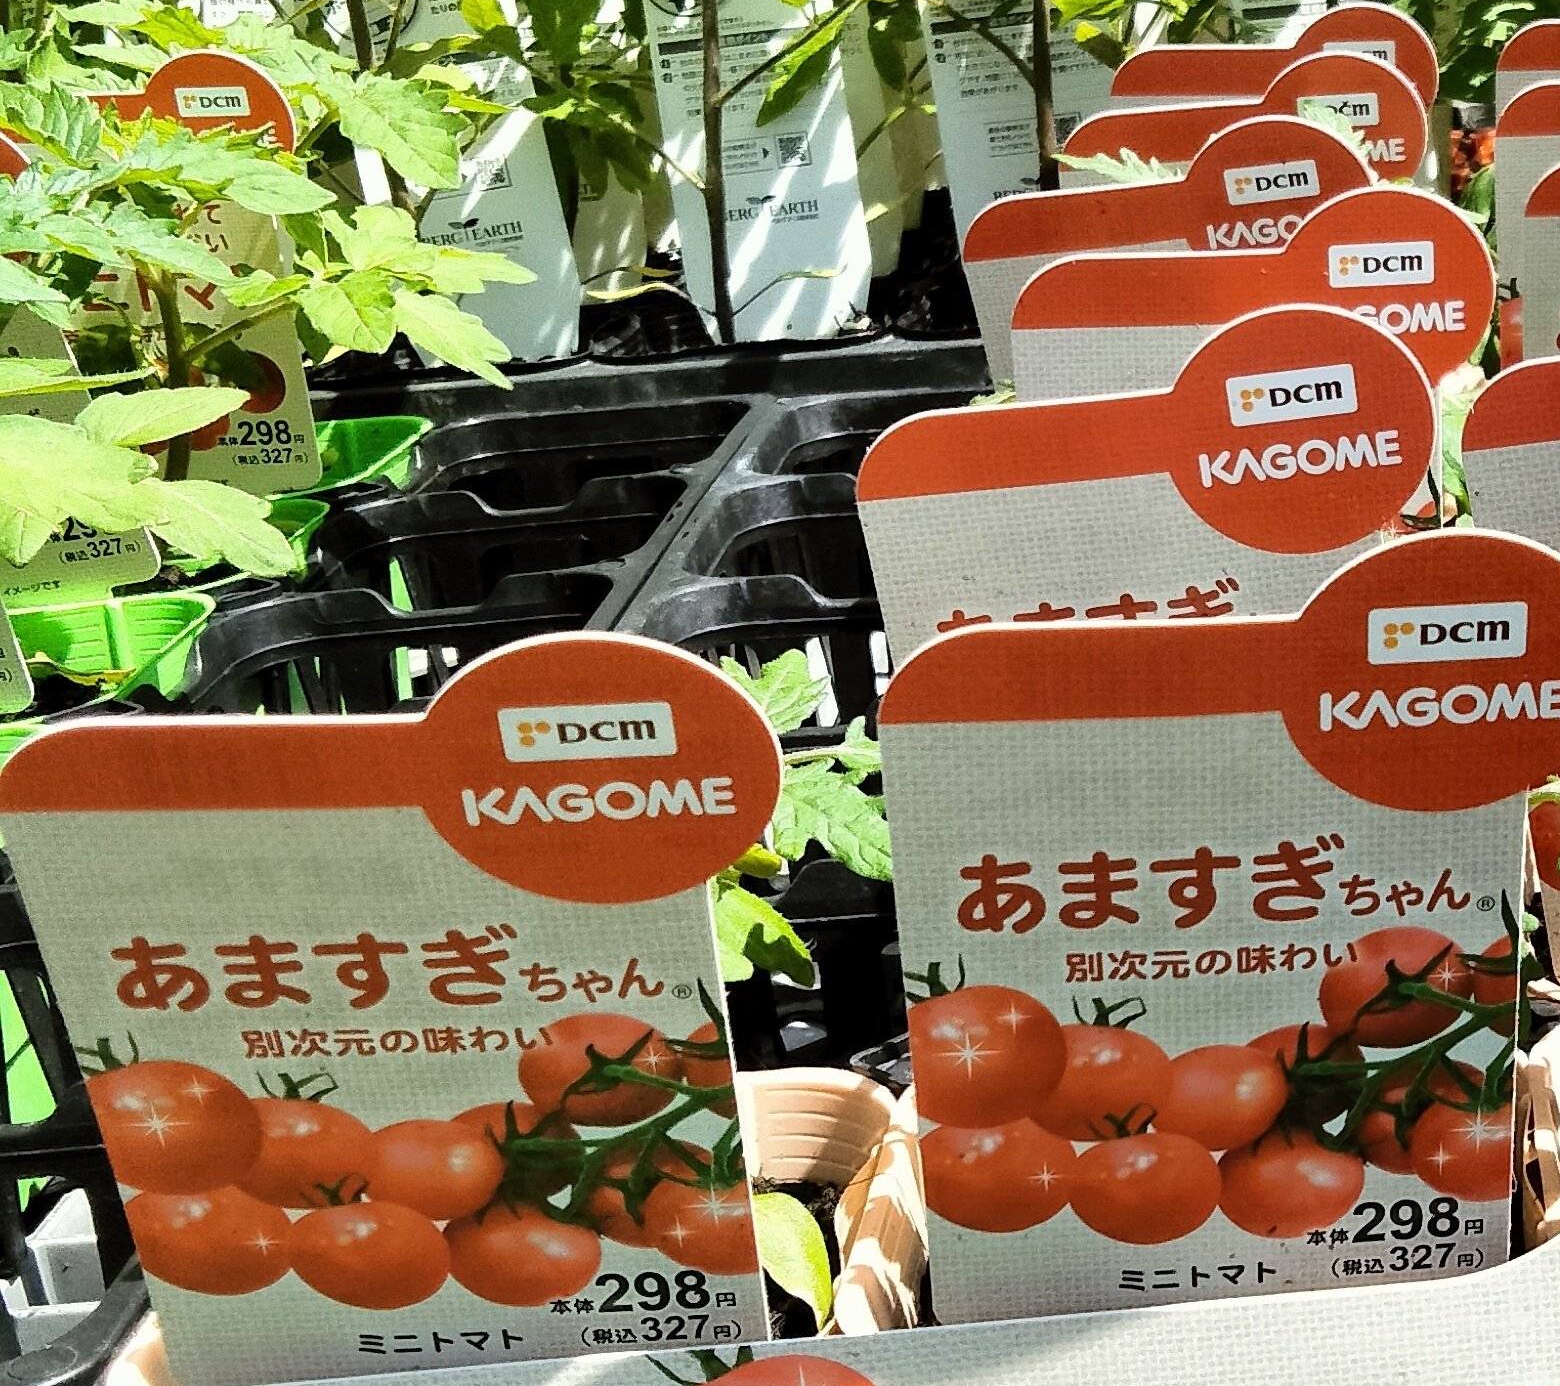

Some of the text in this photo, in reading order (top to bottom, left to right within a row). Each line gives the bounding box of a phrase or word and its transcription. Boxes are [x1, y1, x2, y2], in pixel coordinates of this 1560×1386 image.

[769, 199, 819, 217] EARTH
[472, 220, 524, 242] EARTH
[1206, 215, 1303, 250] KAGO
[1199, 429, 1403, 489] KAGOME
[461, 777, 736, 827] KAGOME
[956, 833, 1471, 935] あますぎちゃん
[111, 923, 665, 1012] あますぎちゃん
[1065, 942, 1359, 983] 別次元の味わい
[241, 1025, 556, 1060] 別次元の味わい
[1306, 1197, 1485, 1248] 本体298円
[549, 1269, 738, 1317] 本体298円
[1118, 1261, 1278, 1293] ミニトマト
[357, 1329, 527, 1356] ミニトマト
